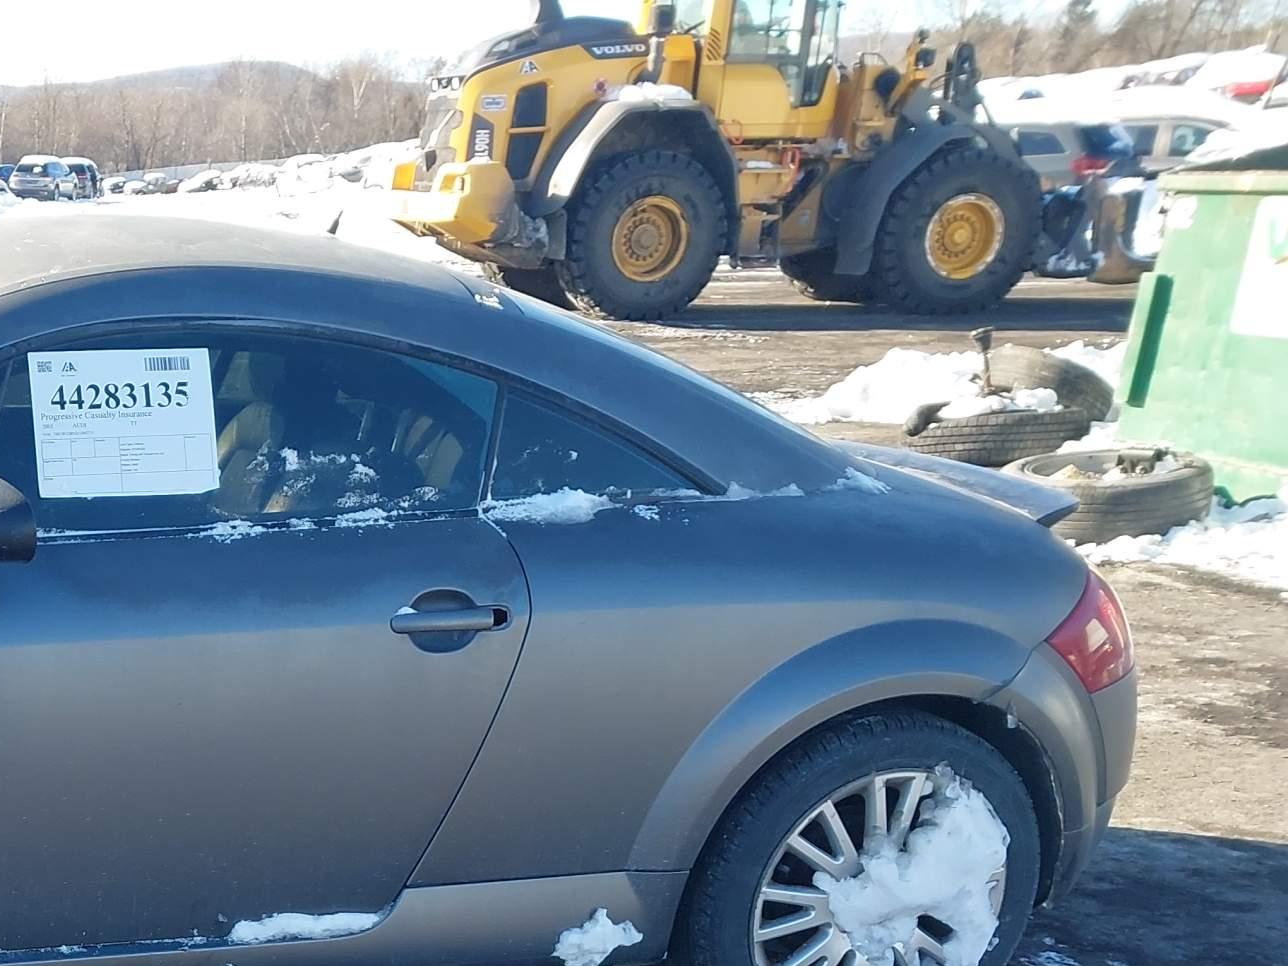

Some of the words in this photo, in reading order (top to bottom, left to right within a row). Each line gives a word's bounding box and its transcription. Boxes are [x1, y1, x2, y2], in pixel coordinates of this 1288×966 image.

[590, 43, 646, 55] VOLVO
[50, 381, 190, 411] 44283135
[40, 412, 83, 422] Progressive
[83, 410, 116, 421] Casualty
[118, 410, 153, 418] Insurance
